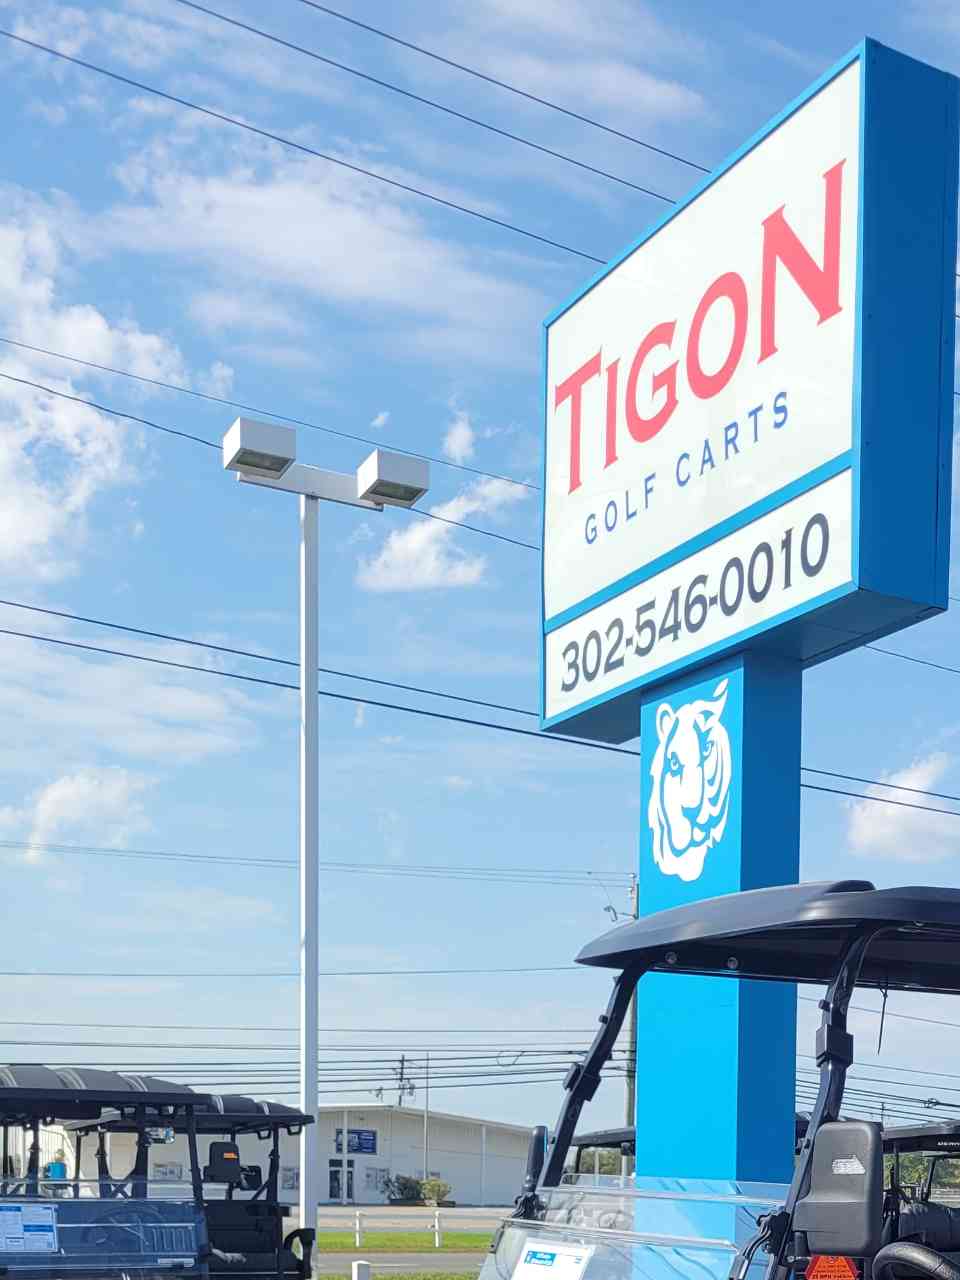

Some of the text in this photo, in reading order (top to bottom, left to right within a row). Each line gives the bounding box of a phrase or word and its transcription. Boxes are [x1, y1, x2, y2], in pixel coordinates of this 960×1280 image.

[555, 158, 847, 495] TIGON
[585, 391, 789, 545] GOLF CARTS
[561, 512, 830, 692] 302-546-0010
